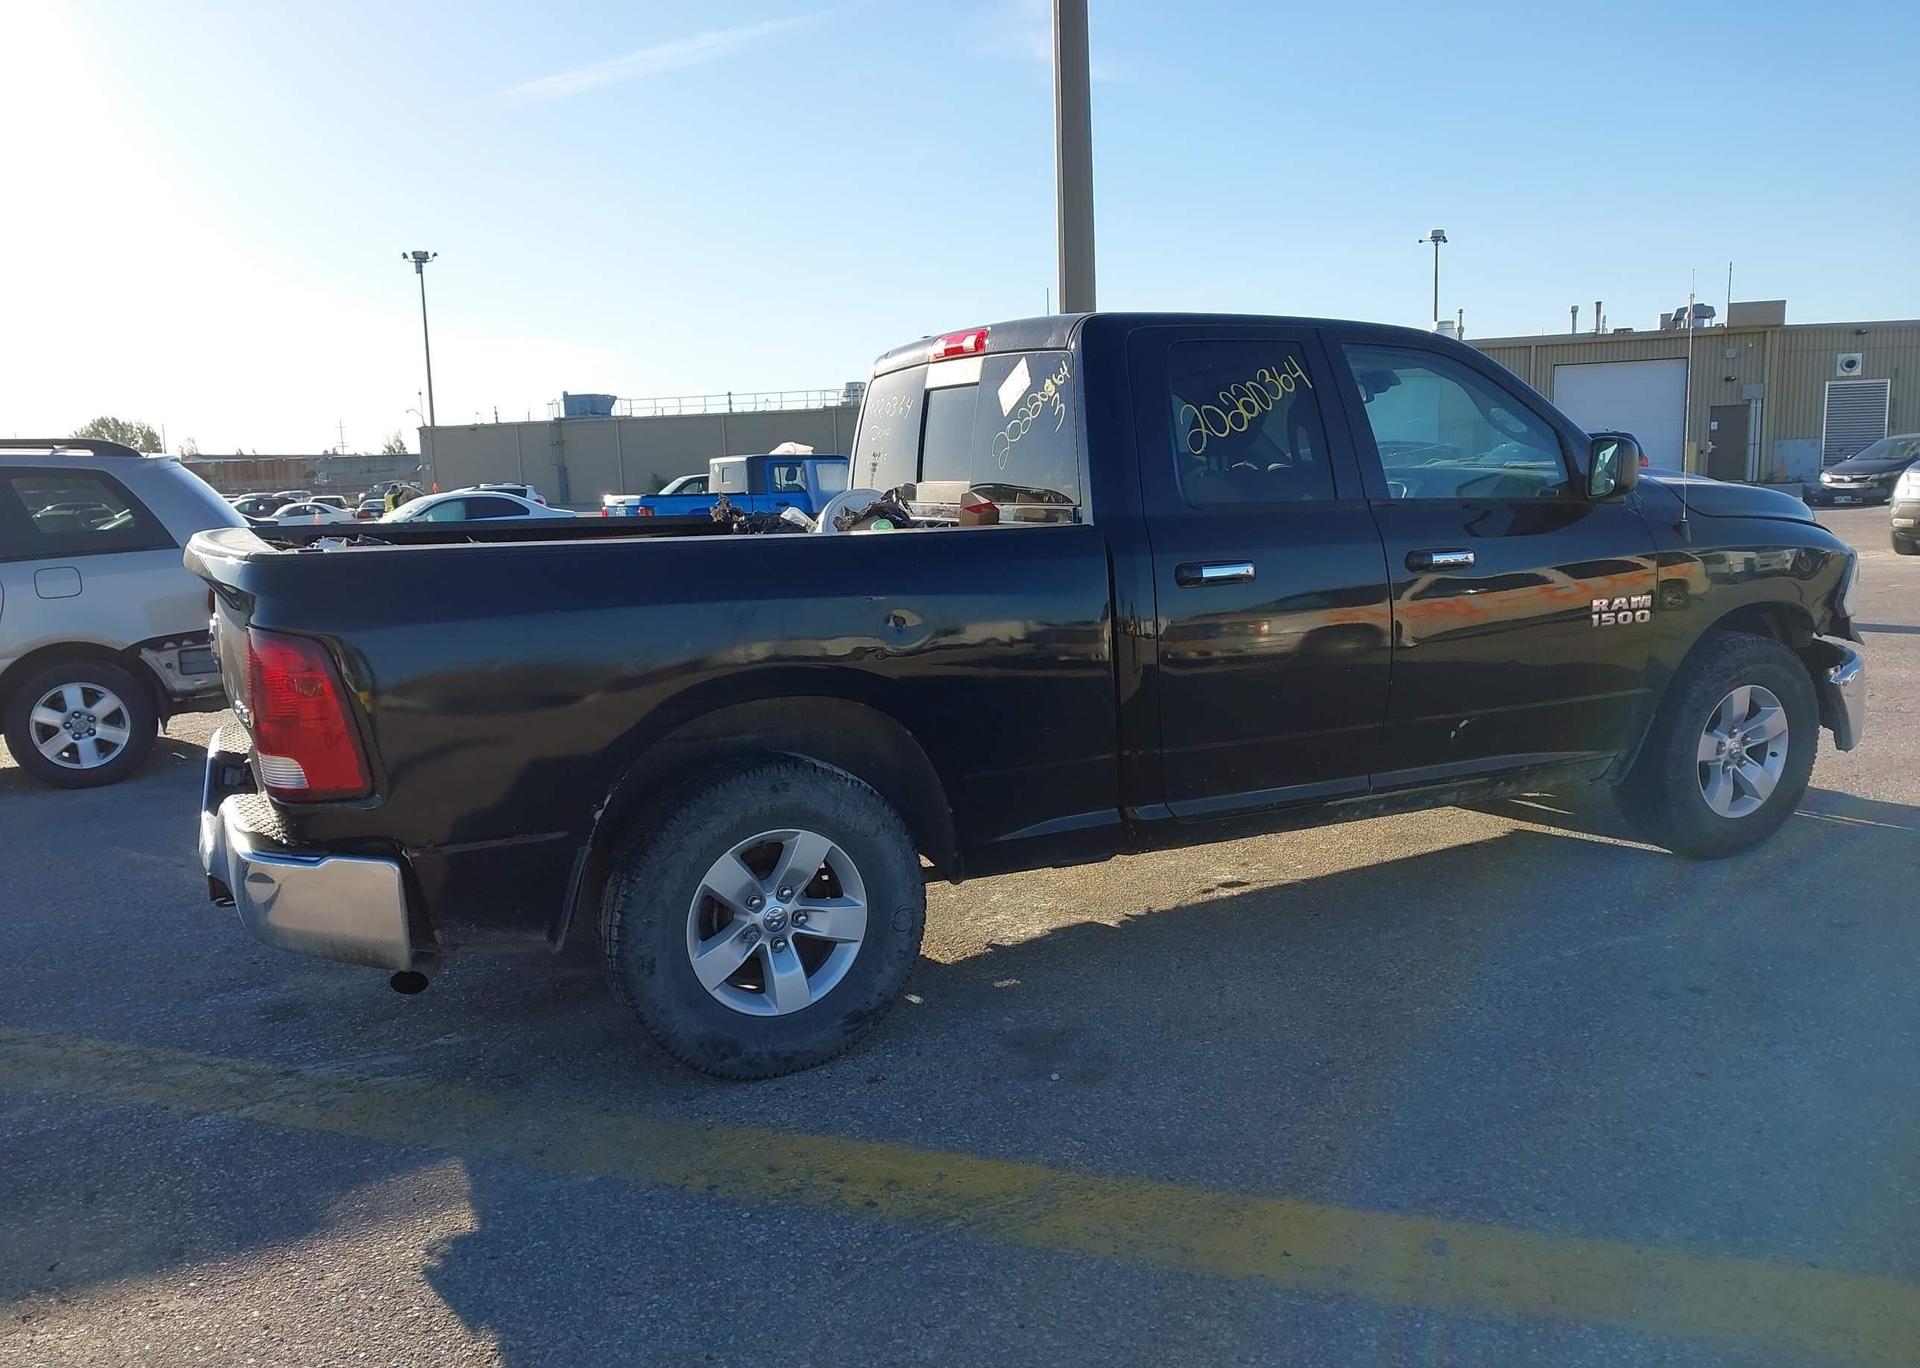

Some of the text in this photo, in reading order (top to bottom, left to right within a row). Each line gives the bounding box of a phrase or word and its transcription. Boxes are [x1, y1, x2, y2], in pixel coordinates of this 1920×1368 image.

[1180, 355, 1313, 455] 20220364
[1592, 594, 1652, 612] RAM
[1592, 609, 1651, 628] 1500
